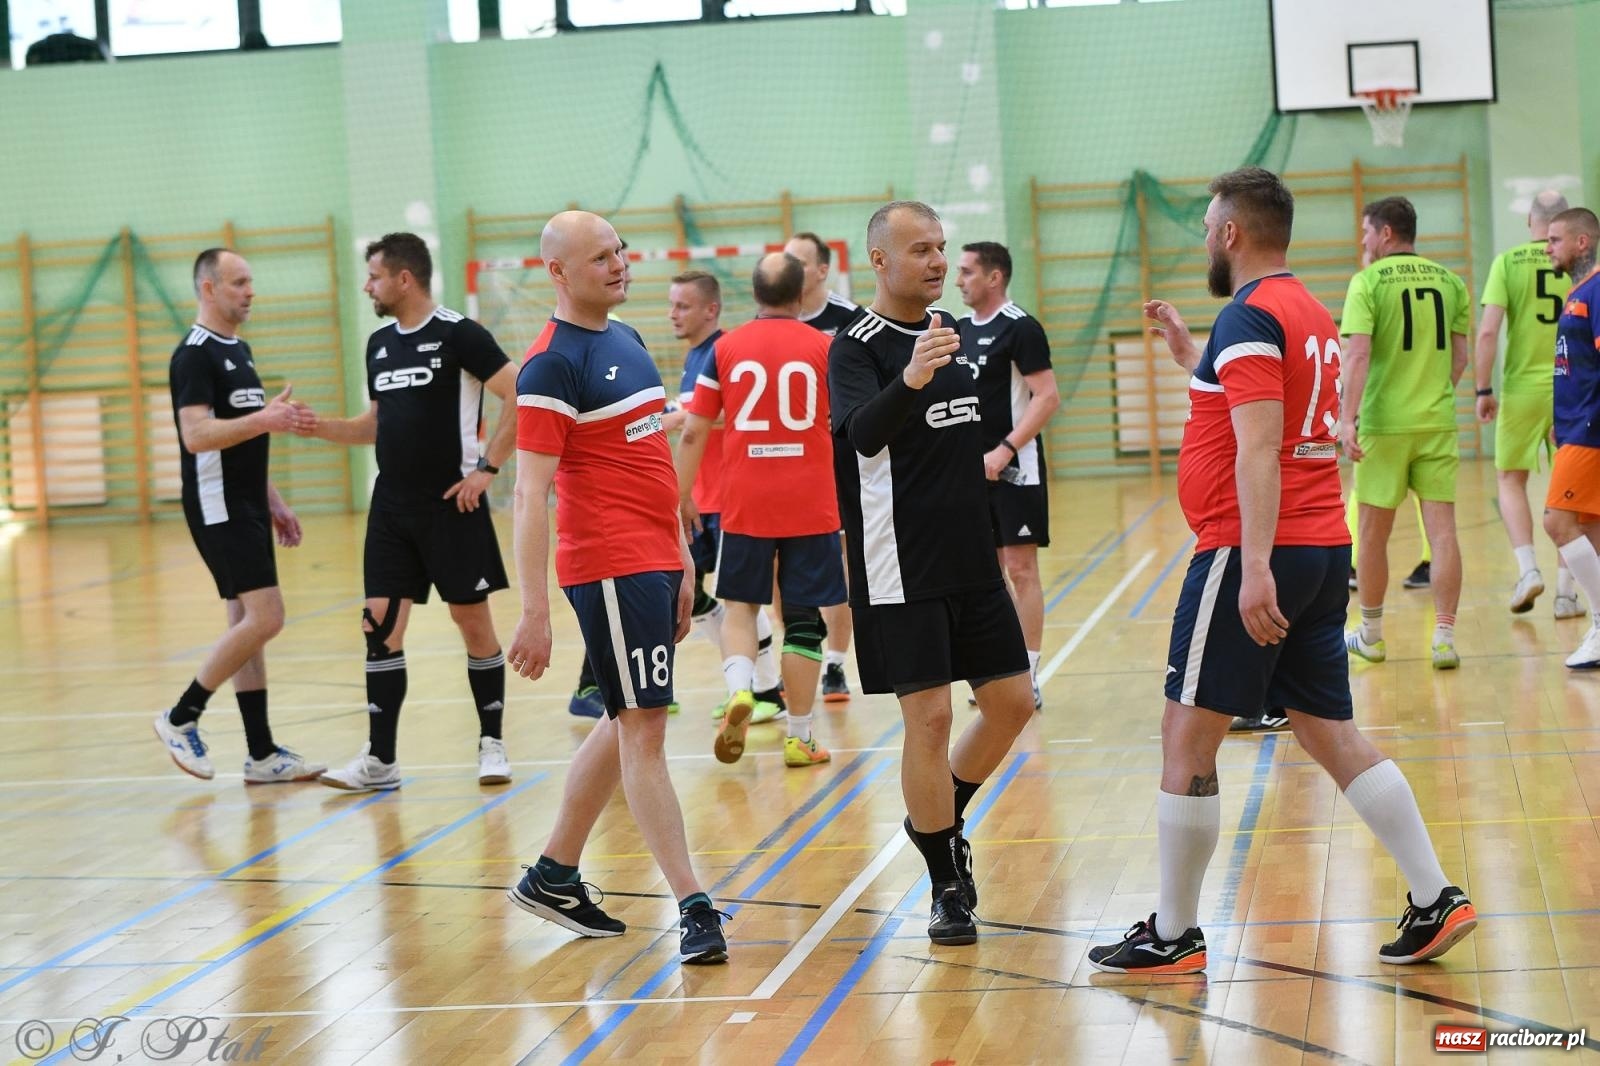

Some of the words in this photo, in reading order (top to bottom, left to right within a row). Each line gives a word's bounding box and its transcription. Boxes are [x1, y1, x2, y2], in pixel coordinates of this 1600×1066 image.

[1402, 287, 1446, 351] 17
[1536, 268, 1564, 325] 5
[374, 366, 434, 392] ESD
[730, 360, 818, 431] 20
[1301, 335, 1342, 438] 13
[631, 644, 670, 690] 18
